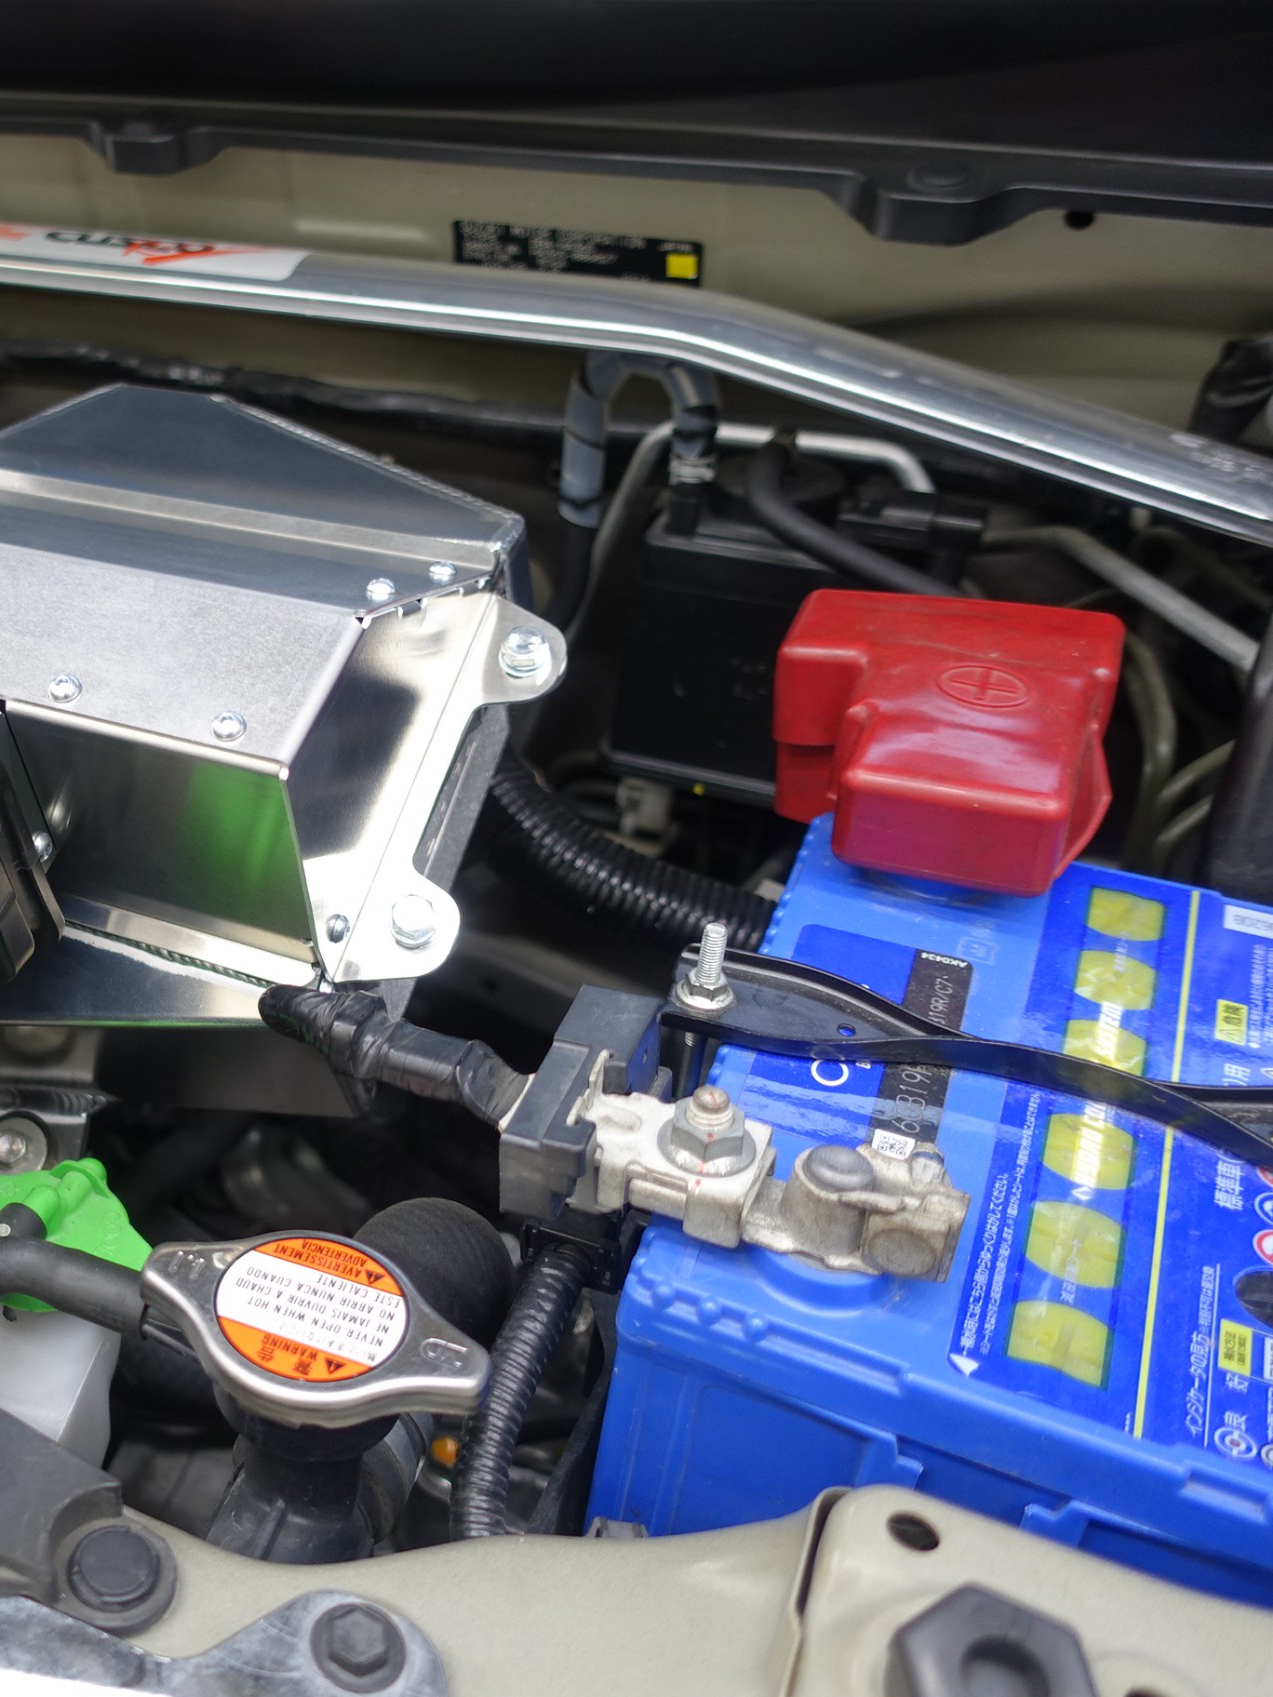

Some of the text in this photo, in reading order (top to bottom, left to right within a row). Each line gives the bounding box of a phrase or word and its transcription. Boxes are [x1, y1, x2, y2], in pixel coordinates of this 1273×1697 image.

[921, 952, 968, 968] AK0434
[273, 1243, 361, 1277] AVERTISSEMENT
[301, 1239, 367, 1267] ADVERTENCIA
[246, 1266, 394, 1320] NO ABRIR NUNCA CUANDO
[373, 1292, 400, 1307] ESTE
[273, 1303, 305, 1321] WHEN
[287, 1293, 326, 1313] OUVRIR
[311, 1316, 341, 1333] OPEN
[330, 1308, 369, 1327] JAMAIS
[346, 1328, 383, 1346] NEVER
[376, 1323, 389, 1333] NE
[261, 1333, 317, 1360] WARNING
